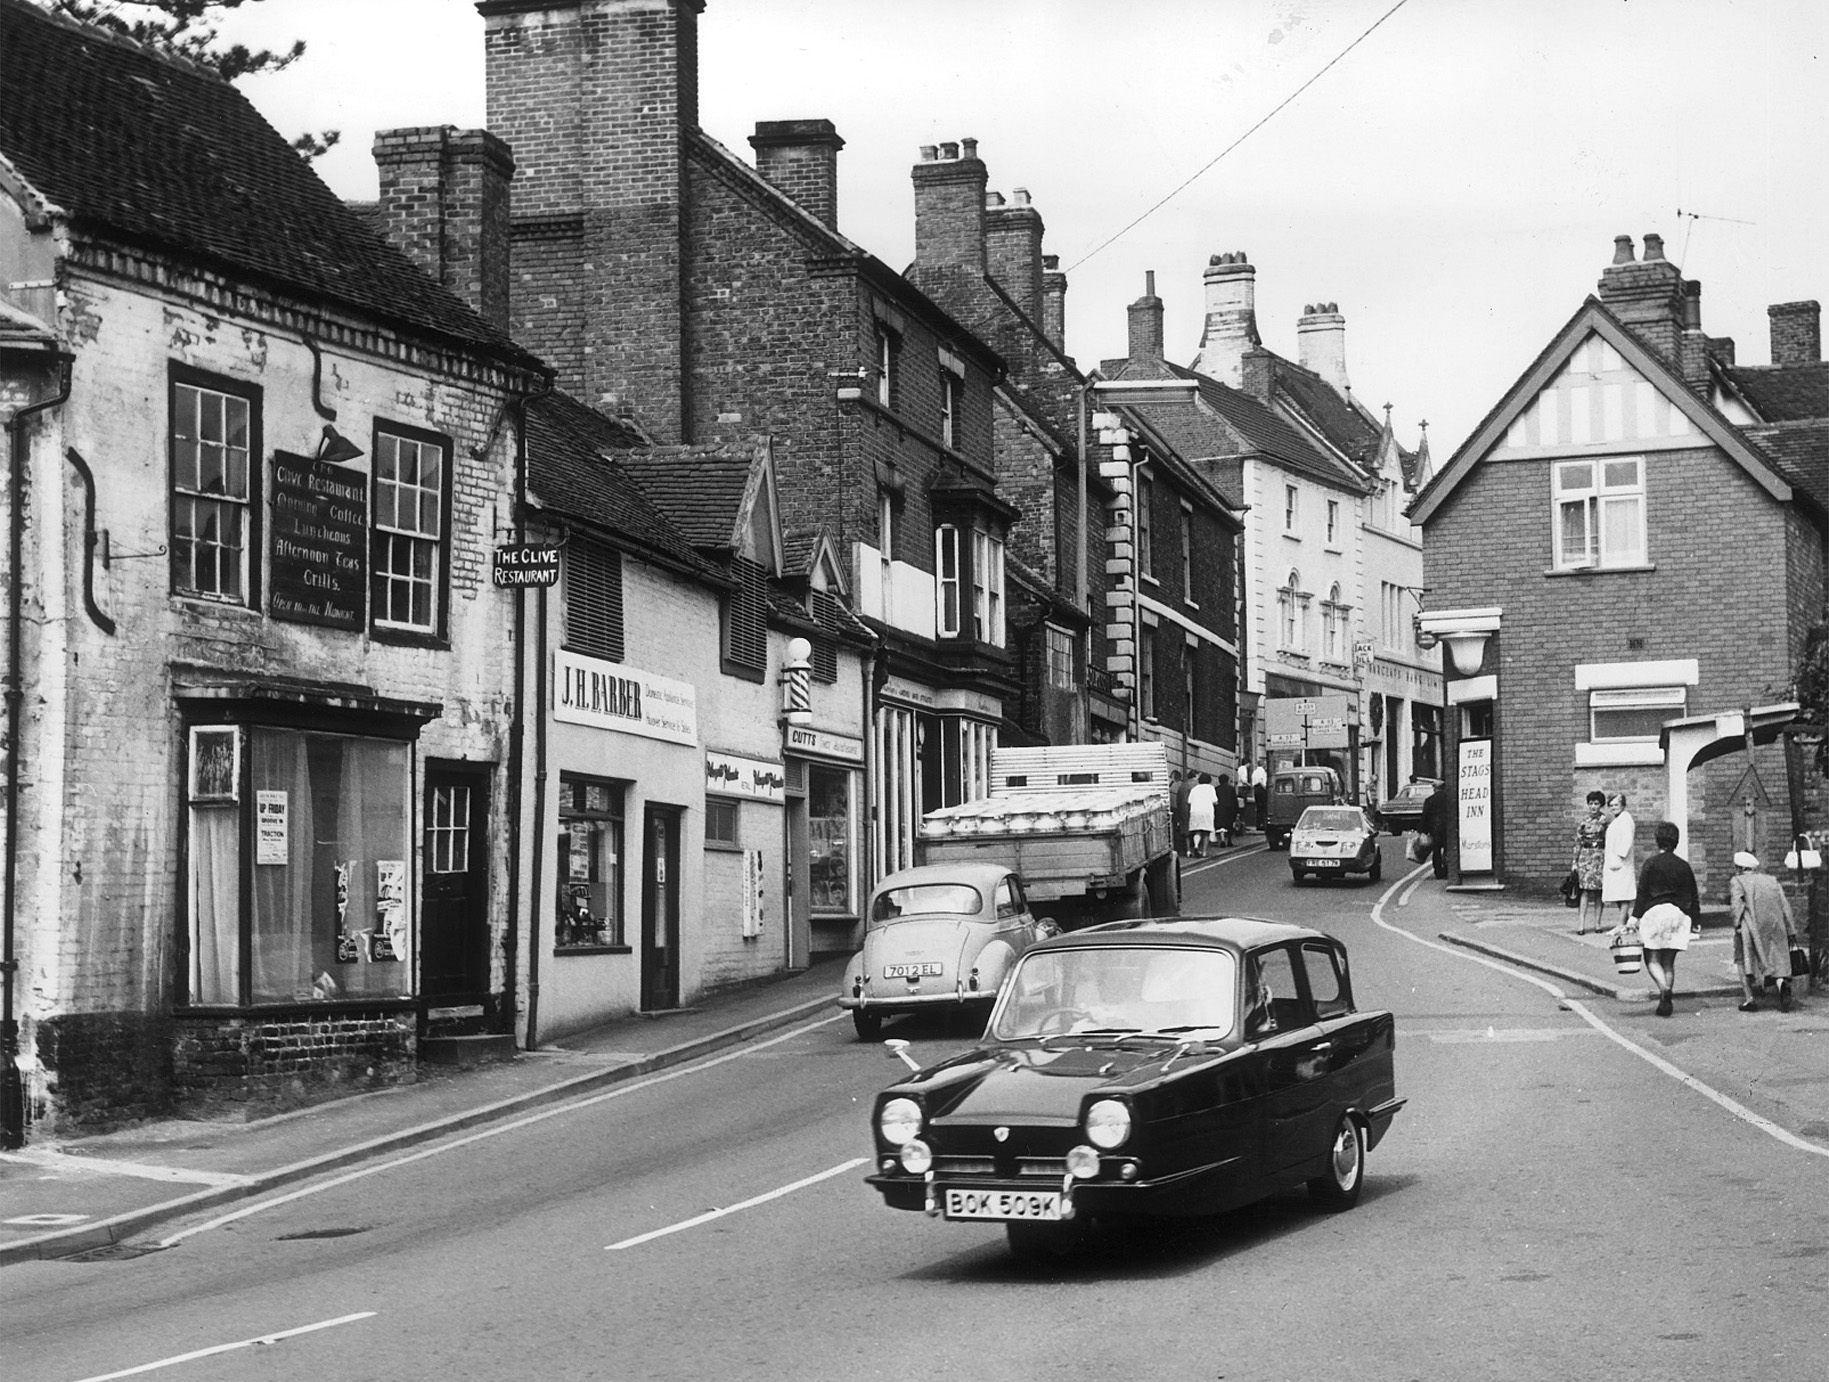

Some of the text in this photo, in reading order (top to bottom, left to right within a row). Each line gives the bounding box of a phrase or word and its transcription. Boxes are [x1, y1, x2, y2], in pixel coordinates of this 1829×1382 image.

[276, 538, 360, 571] Afternoon Teas
[495, 548, 558, 564] THE CLIVE
[494, 567, 557, 585] RESTAURANT
[1355, 644, 1372, 653] JACK
[1355, 656, 1371, 664] JILL
[591, 671, 643, 721] BARBER
[792, 730, 817, 746] CUTTS
[1467, 749, 1485, 759] THE
[1460, 764, 1491, 778] STAGS
[1460, 787, 1489, 801] HEAD
[1466, 805, 1485, 818] INN
[889, 964, 937, 976] 7012 EL
[999, 1194, 1056, 1217] 509K
